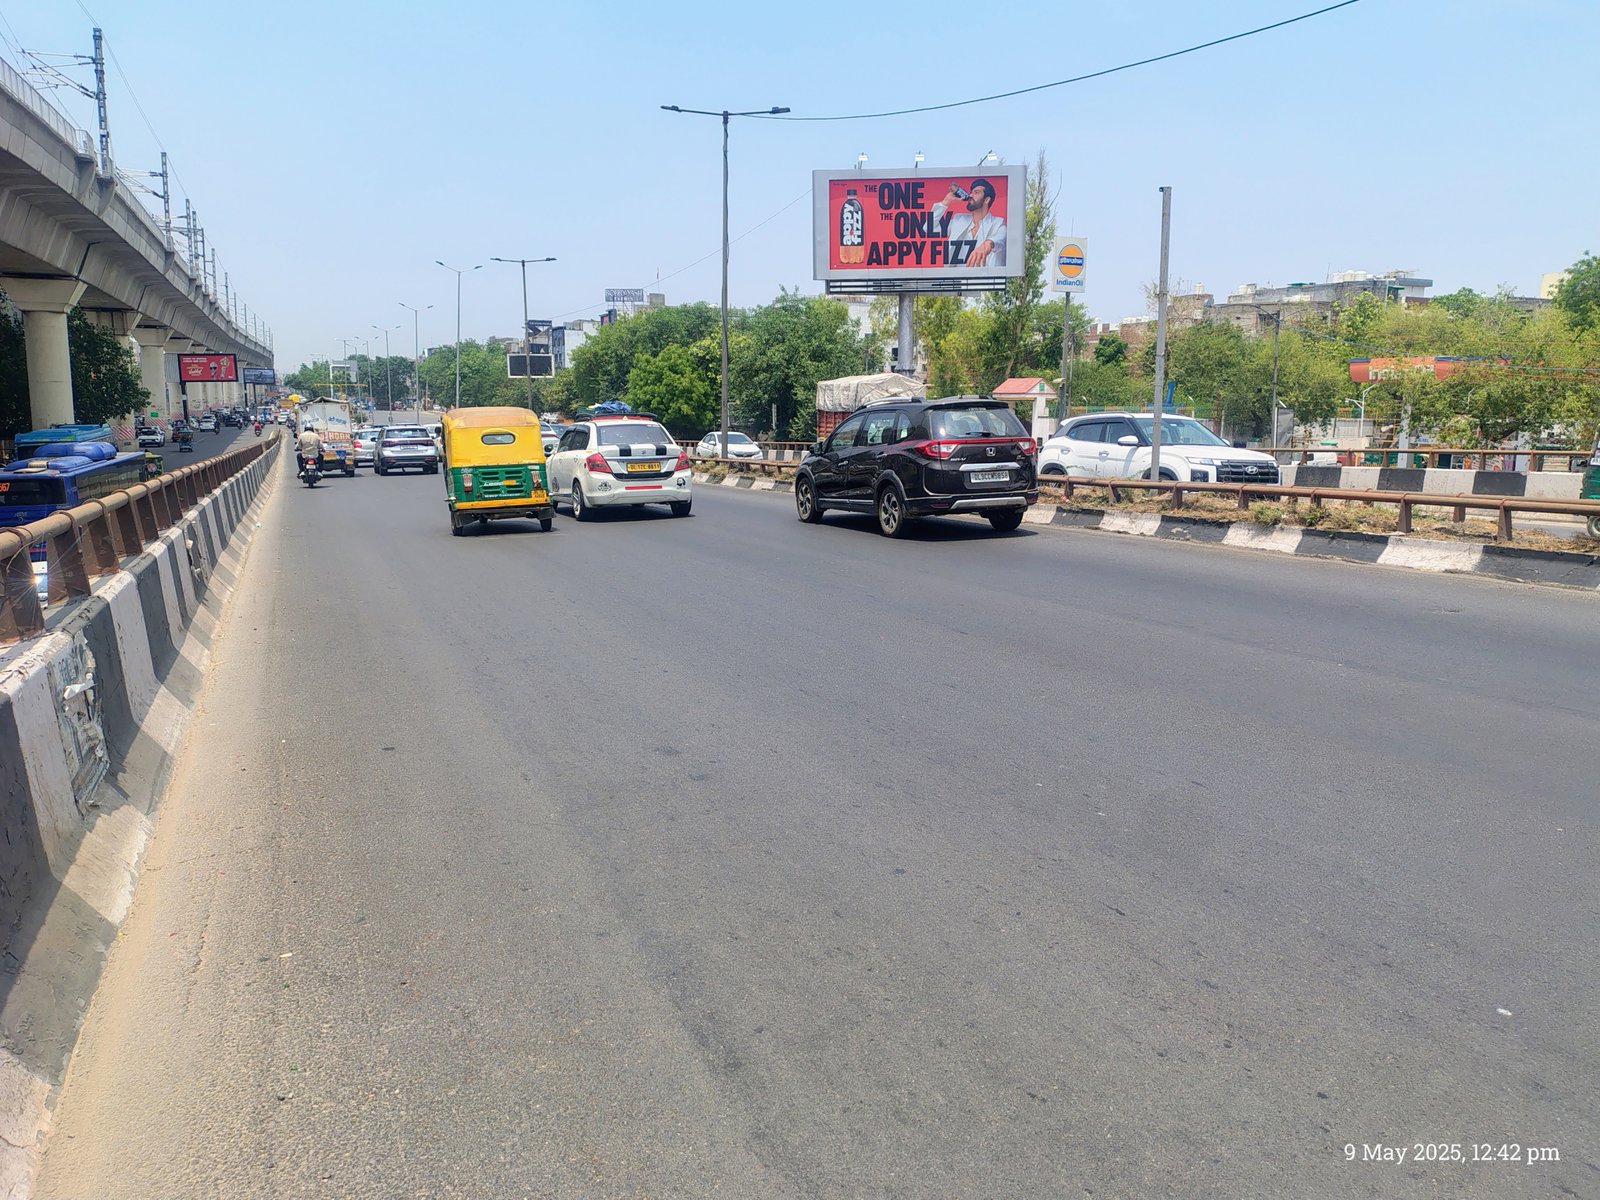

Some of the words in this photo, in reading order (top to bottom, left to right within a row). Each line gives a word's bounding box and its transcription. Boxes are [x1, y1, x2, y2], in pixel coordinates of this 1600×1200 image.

[864, 184, 877, 192] THE
[878, 182, 925, 210] ONE
[880, 212, 893, 220] THE
[894, 211, 953, 239] ONLY
[866, 240, 926, 265] APPY
[930, 240, 977, 265] FIZZ
